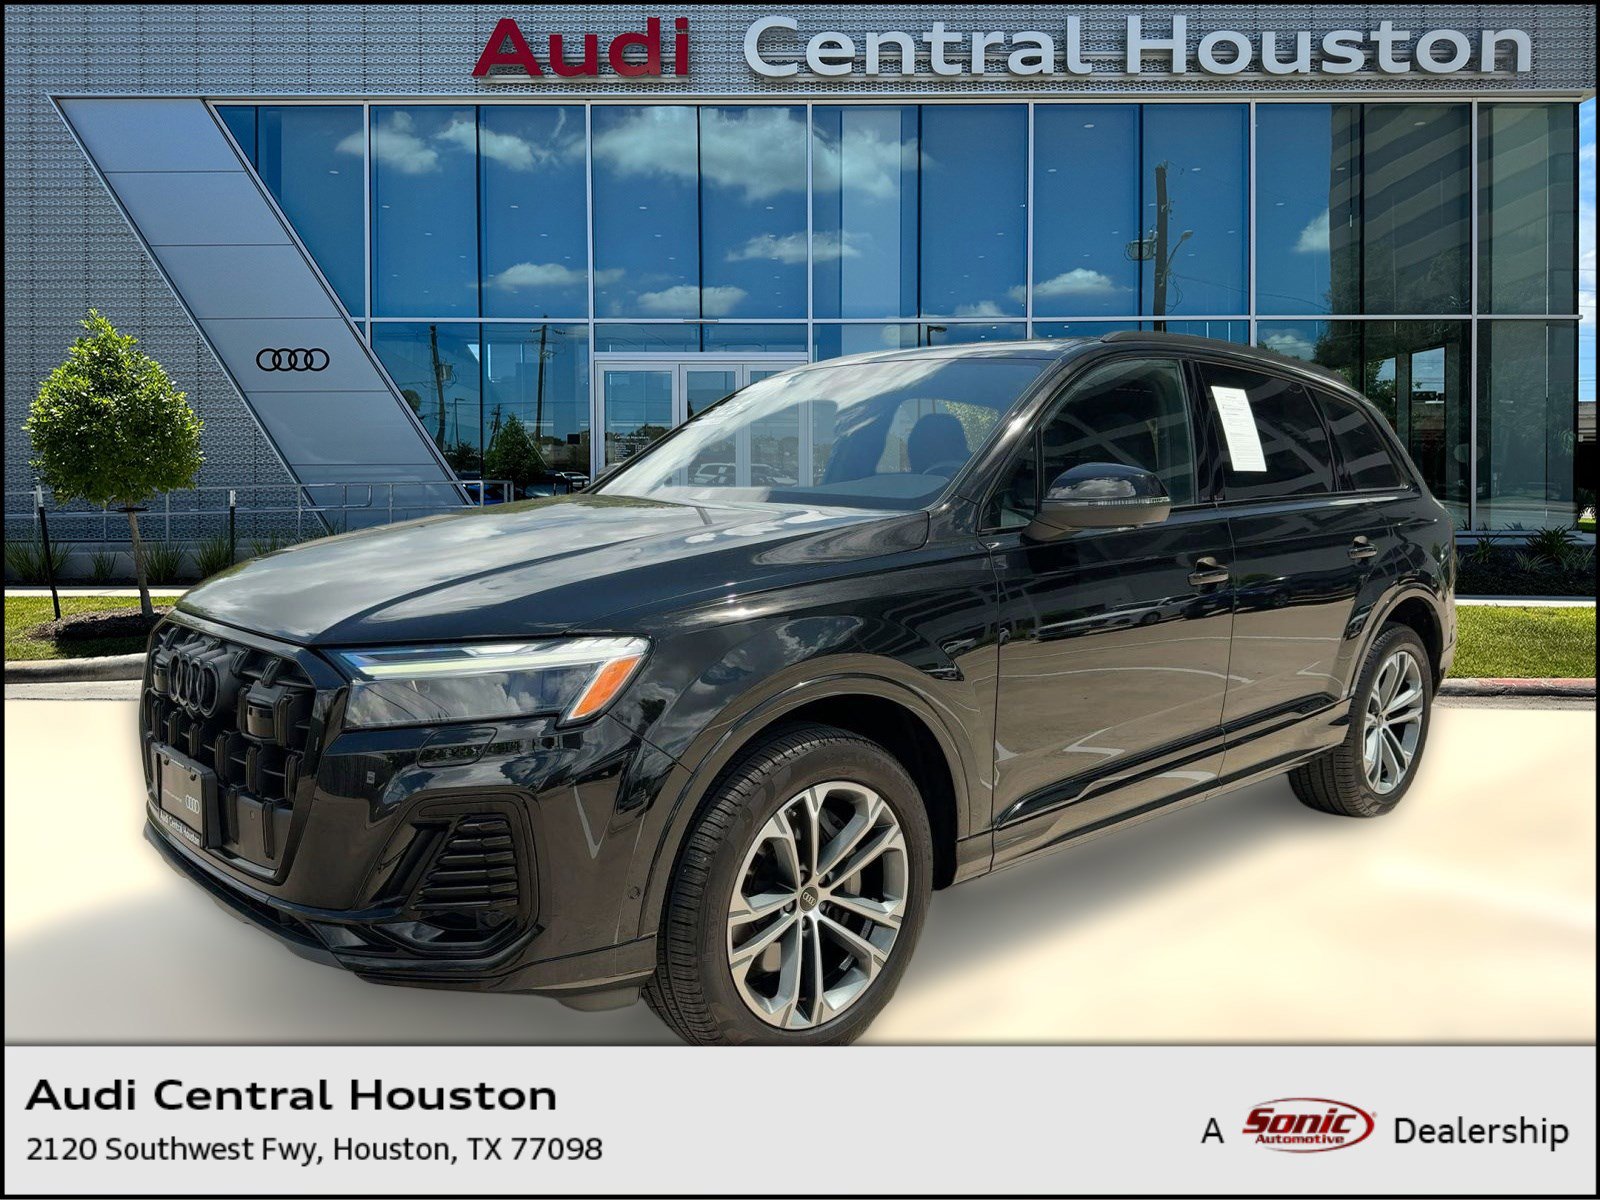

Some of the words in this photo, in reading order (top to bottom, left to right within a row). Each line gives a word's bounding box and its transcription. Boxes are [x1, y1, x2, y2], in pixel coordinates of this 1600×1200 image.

[471, 17, 689, 78] Audi
[743, 15, 1092, 77] Central
[1125, 15, 1532, 75] Houston
